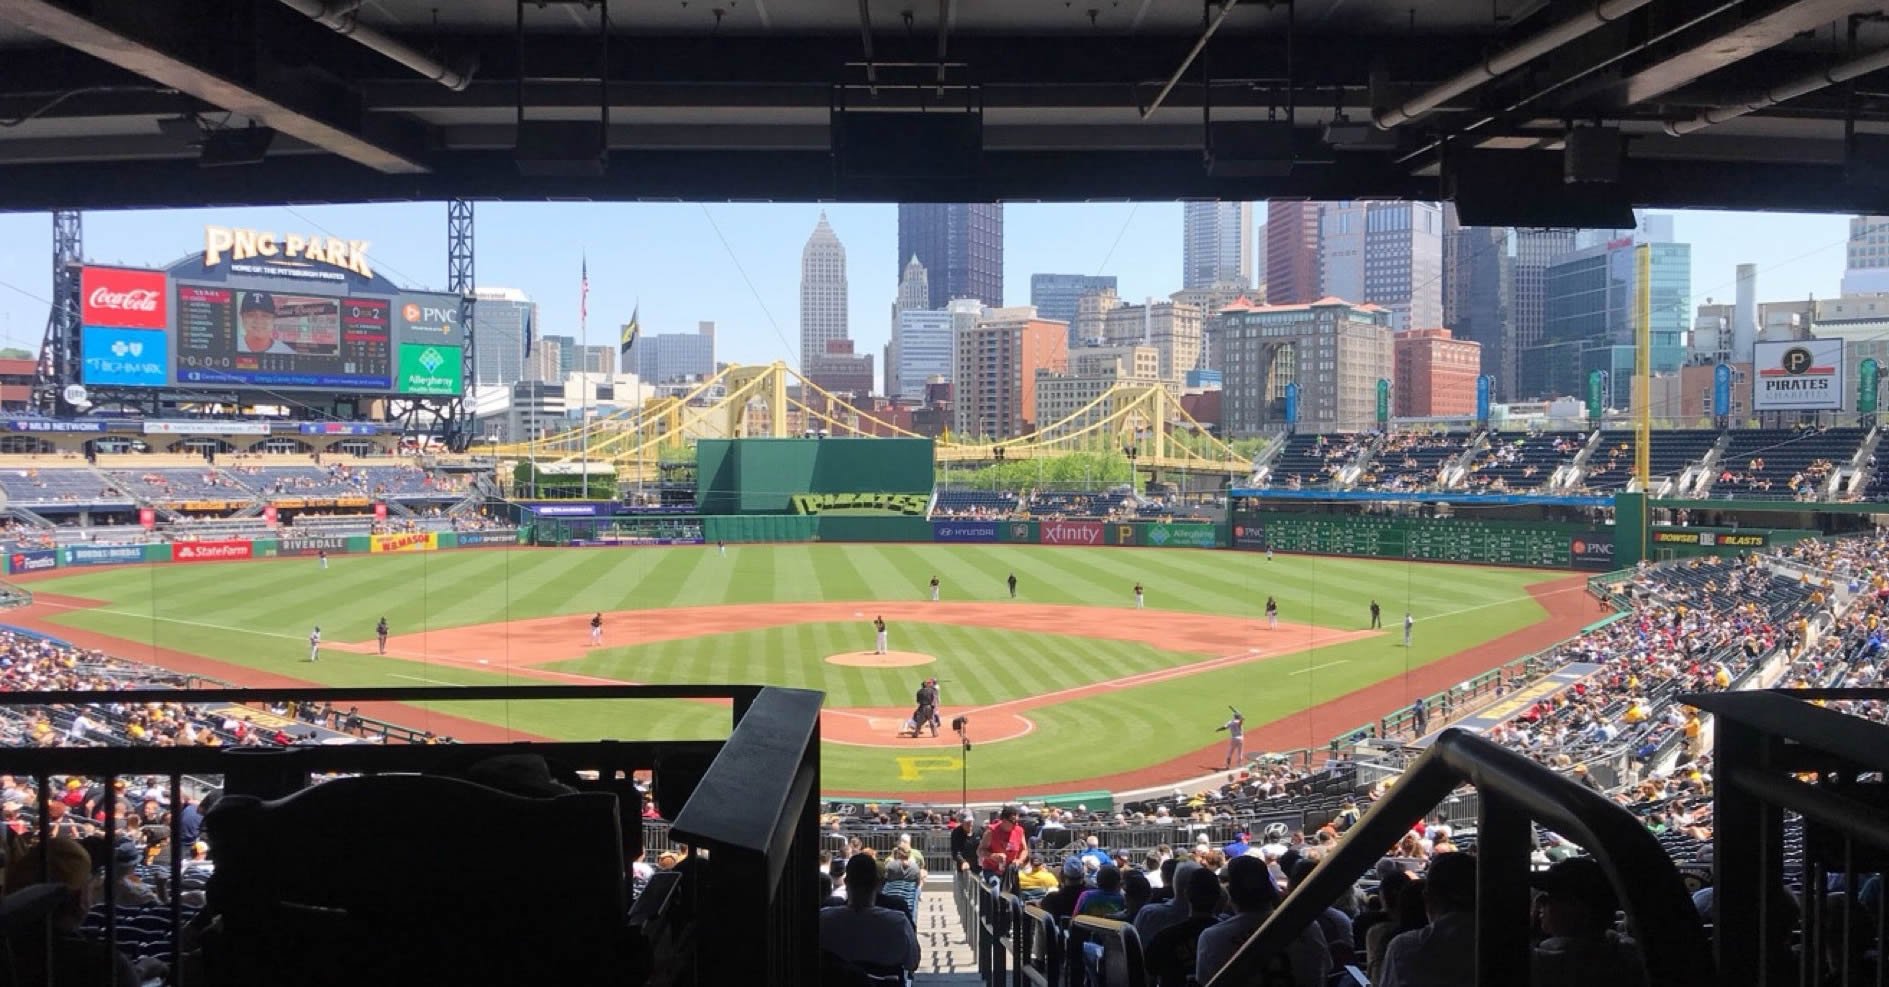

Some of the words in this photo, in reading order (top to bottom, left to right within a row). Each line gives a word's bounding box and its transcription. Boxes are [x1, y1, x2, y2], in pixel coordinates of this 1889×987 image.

[205, 225, 280, 266] PNC
[285, 233, 373, 279] PARK
[89, 287, 160, 312] Coca-Cola
[424, 308, 457, 323] PNC
[1791, 353, 1805, 371] P
[408, 376, 453, 386] Allegheny
[1766, 379, 1828, 391] PIRATES
[29, 422, 51, 431] MLB
[53, 423, 99, 431] NETWORK
[792, 493, 929, 516] PIRATES
[1045, 525, 1099, 543] xfinity
[1119, 526, 1132, 544] P
[1245, 529, 1263, 538] PNC
[1660, 533, 1698, 543] BOWSER
[283, 539, 343, 550] RIVENDALE
[1726, 536, 1763, 546] BLASTS
[1587, 543, 1614, 555] PNC
[896, 756, 963, 781] P
